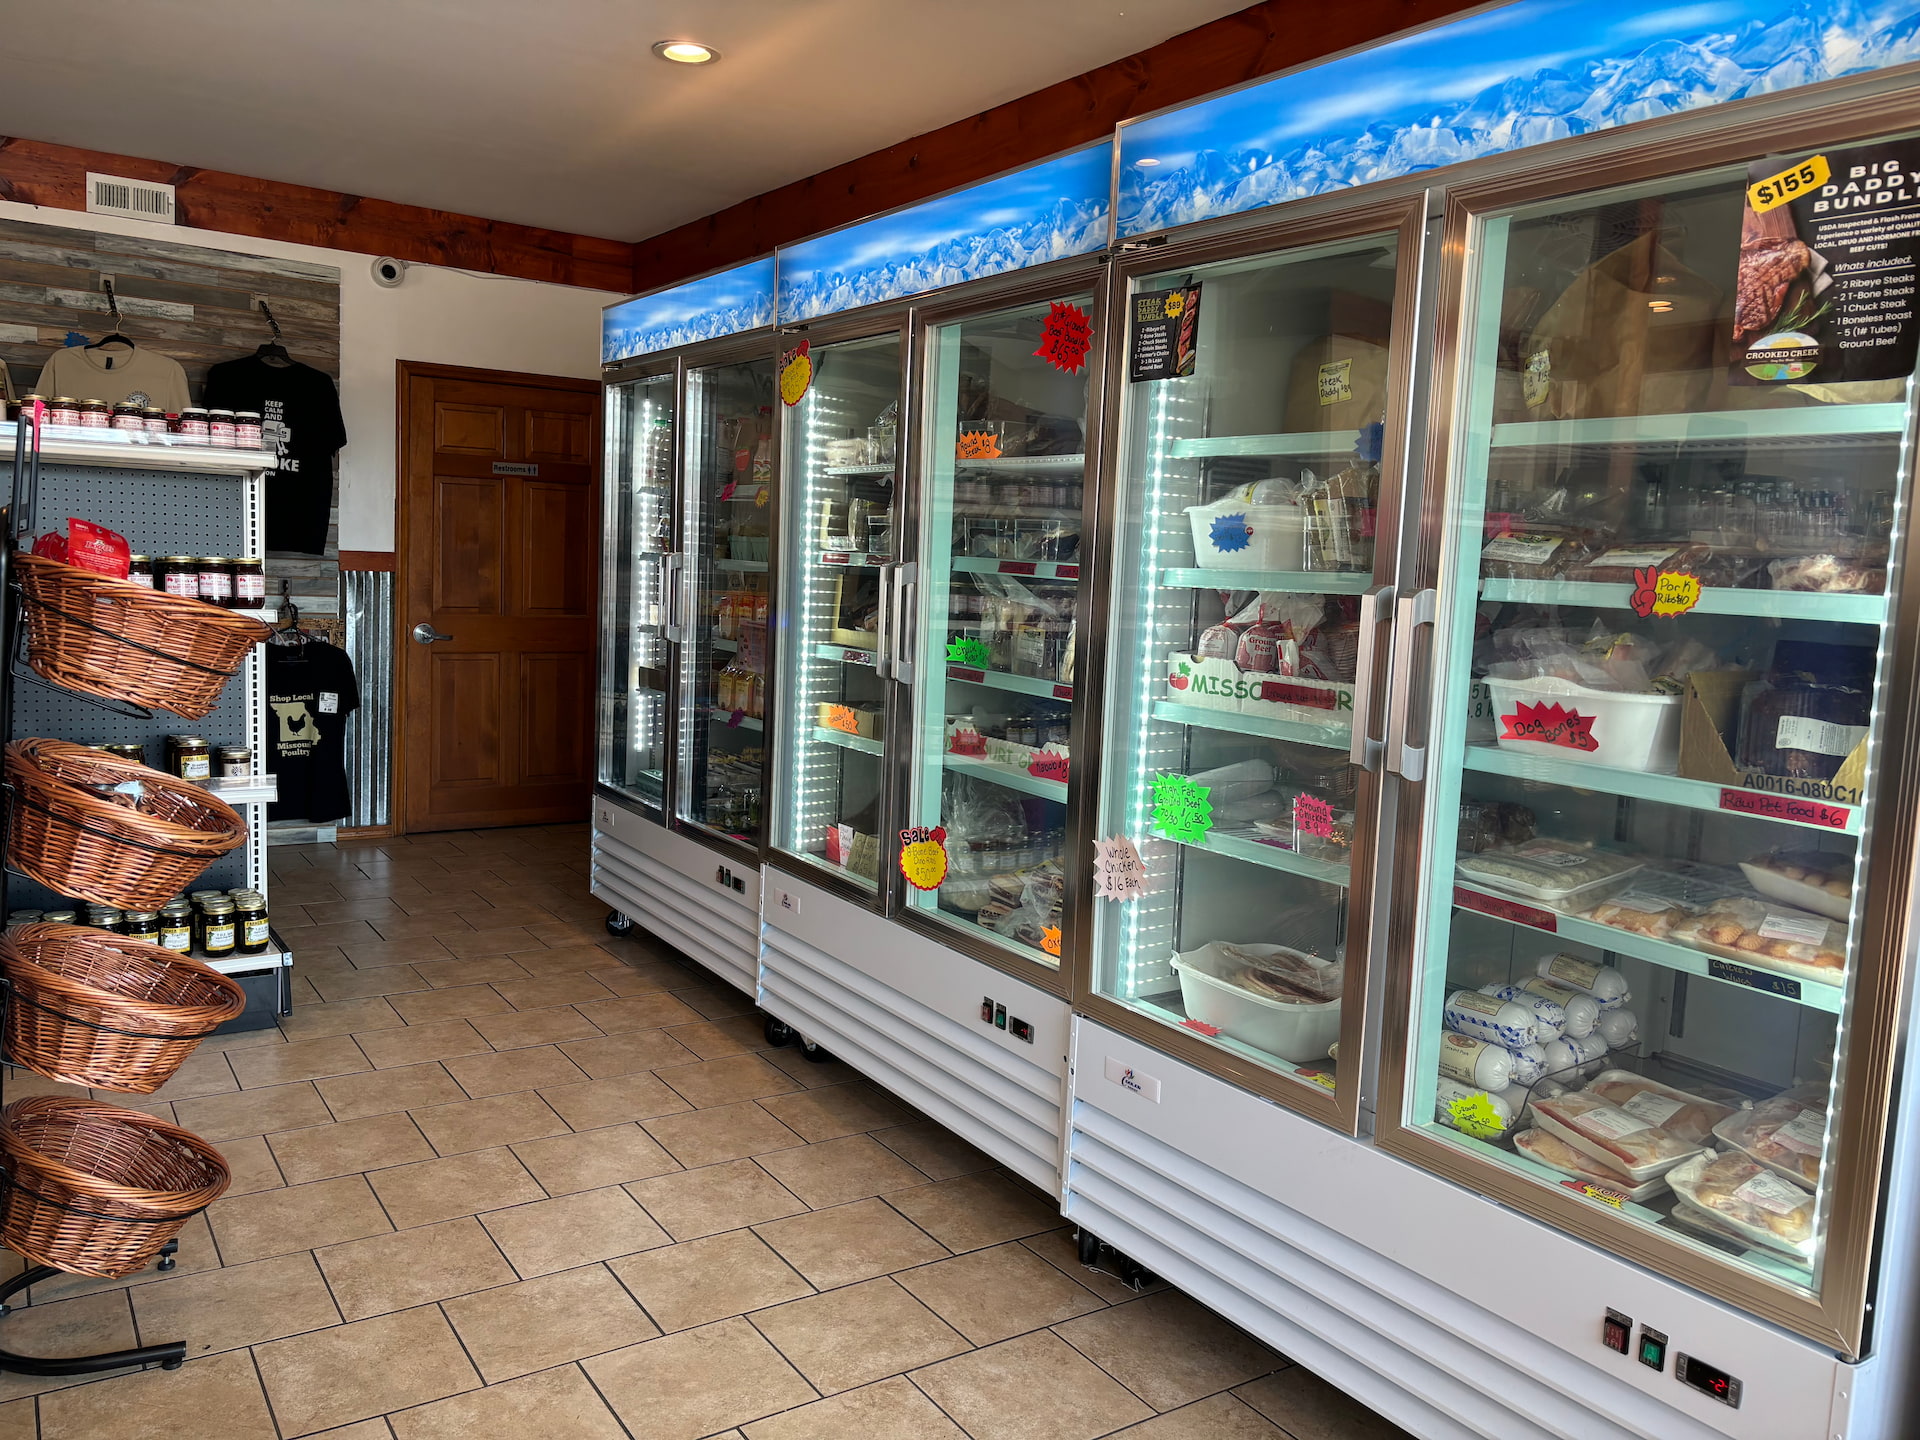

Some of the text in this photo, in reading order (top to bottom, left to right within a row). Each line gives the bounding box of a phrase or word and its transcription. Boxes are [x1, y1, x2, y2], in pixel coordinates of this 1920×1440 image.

[1850, 160, 1900, 179] BIG
[1757, 165, 1816, 206] $155
[1818, 223, 1837, 232] USDA
[1838, 218, 1873, 230] Inspected
[1816, 230, 1853, 241] Experience
[1861, 224, 1886, 234] variety
[1858, 235, 1874, 244] AND
[1874, 229, 1910, 242] HORMONE
[1849, 244, 1866, 253] BEEF
[1835, 261, 1865, 272] Whats
[1842, 274, 1916, 289] 2 Ribeye Steaks
[1840, 286, 1915, 301] 2 T-Bone Steaks
[1137, 305, 1160, 314] DADDY
[1138, 298, 1180, 310] STEAK $89
[1848, 302, 1879, 313] Chuck
[1880, 299, 1907, 309] Steak
[1137, 311, 1165, 322] BUNDLE
[1842, 313, 1884, 325] Boneless
[1885, 310, 1913, 321] Roast
[1844, 328, 1851, 337] 5
[1870, 322, 1902, 334] Tubes)
[1839, 336, 1897, 349] Ground Beef
[1745, 348, 1819, 360] CROOKED CREEK
[264, 400, 284, 408] KEEP
[263, 413, 283, 421] AND
[493, 464, 526, 473] Restrooms
[1660, 578, 1692, 593] Pork
[1254, 644, 1272, 653] Beef
[269, 692, 315, 703] Shop Local
[1513, 713, 1581, 743] Dog Bones
[1568, 731, 1588, 748] $5
[281, 749, 311, 758] Poultry
[1181, 785, 1196, 799] Fat
[1184, 797, 1204, 810] Beef
[1723, 792, 1844, 827] Raw Pet Food $6
[1105, 846, 1131, 860] Whole
[1104, 859, 1139, 874] Chicken
[1105, 875, 1141, 892] $16 Each
[1712, 960, 1754, 976] CHICKEN
[1772, 981, 1797, 996] $15
